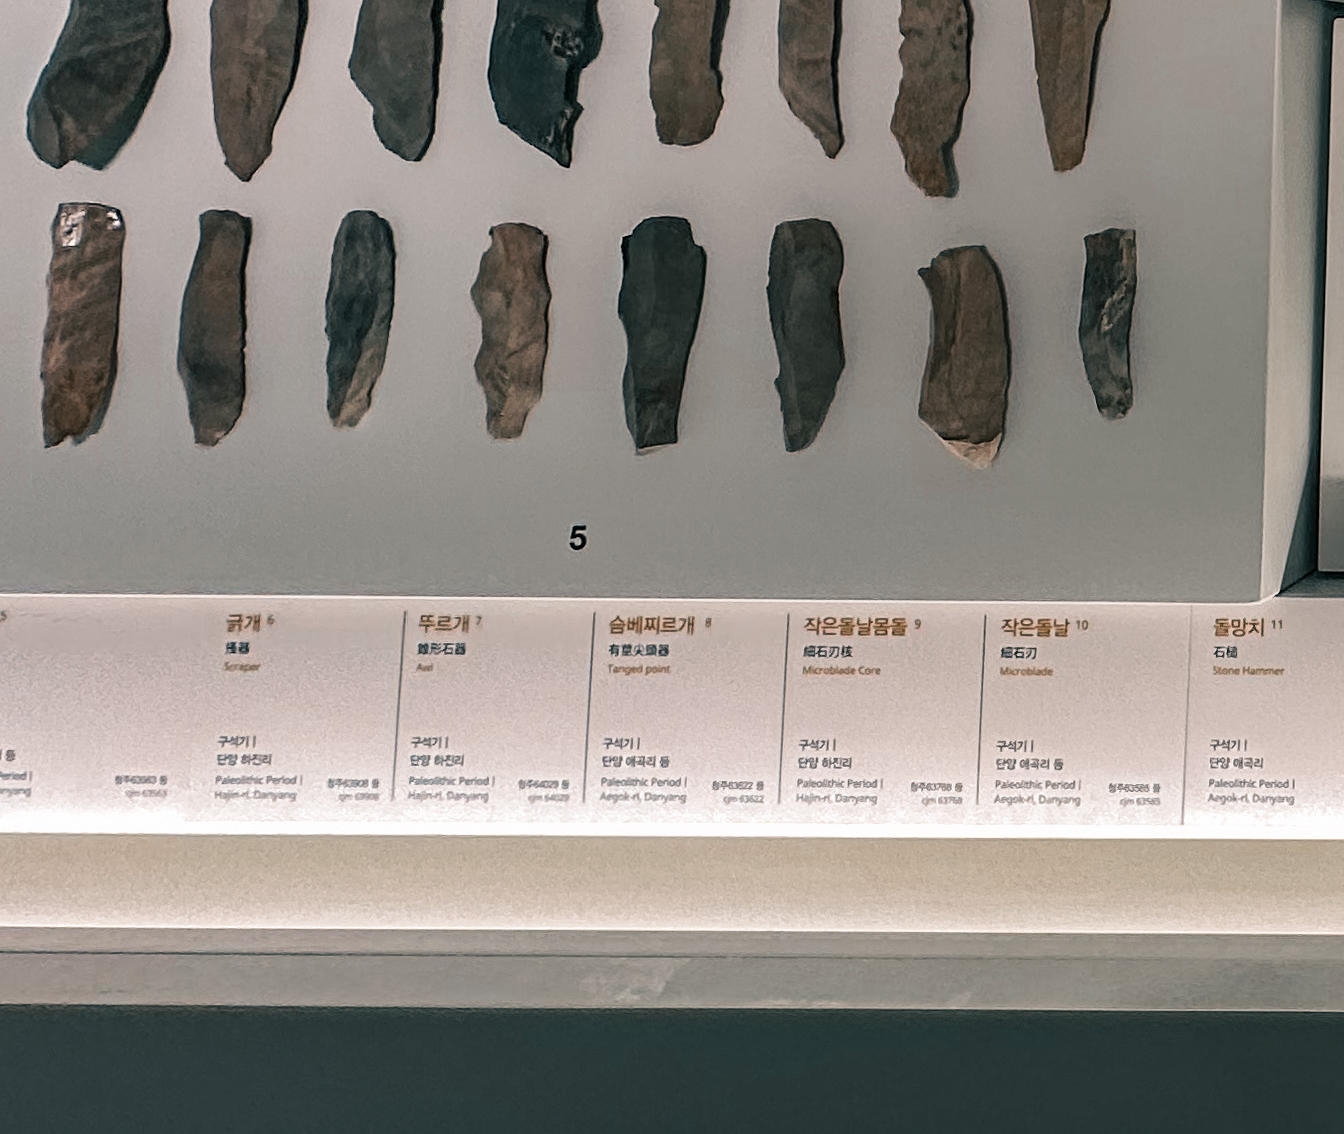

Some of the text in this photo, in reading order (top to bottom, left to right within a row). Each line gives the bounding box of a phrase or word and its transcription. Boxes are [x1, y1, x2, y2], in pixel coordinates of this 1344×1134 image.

[568, 524, 588, 551] 5
[226, 613, 275, 633] 긁개 6
[609, 615, 712, 636] 슴베찌르개 8
[804, 616, 922, 636] 작은돌날몸돌 9
[1001, 618, 1089, 638] 작은돌날 10
[1213, 618, 1282, 638] 돌망치 11
[608, 663, 671, 676] Tanged point
[802, 665, 881, 676] Microblade Core
[1000, 666, 1054, 676] Microblade
[1212, 665, 1285, 676] Stone Hammer
[1210, 739, 1241, 752] 구석기
